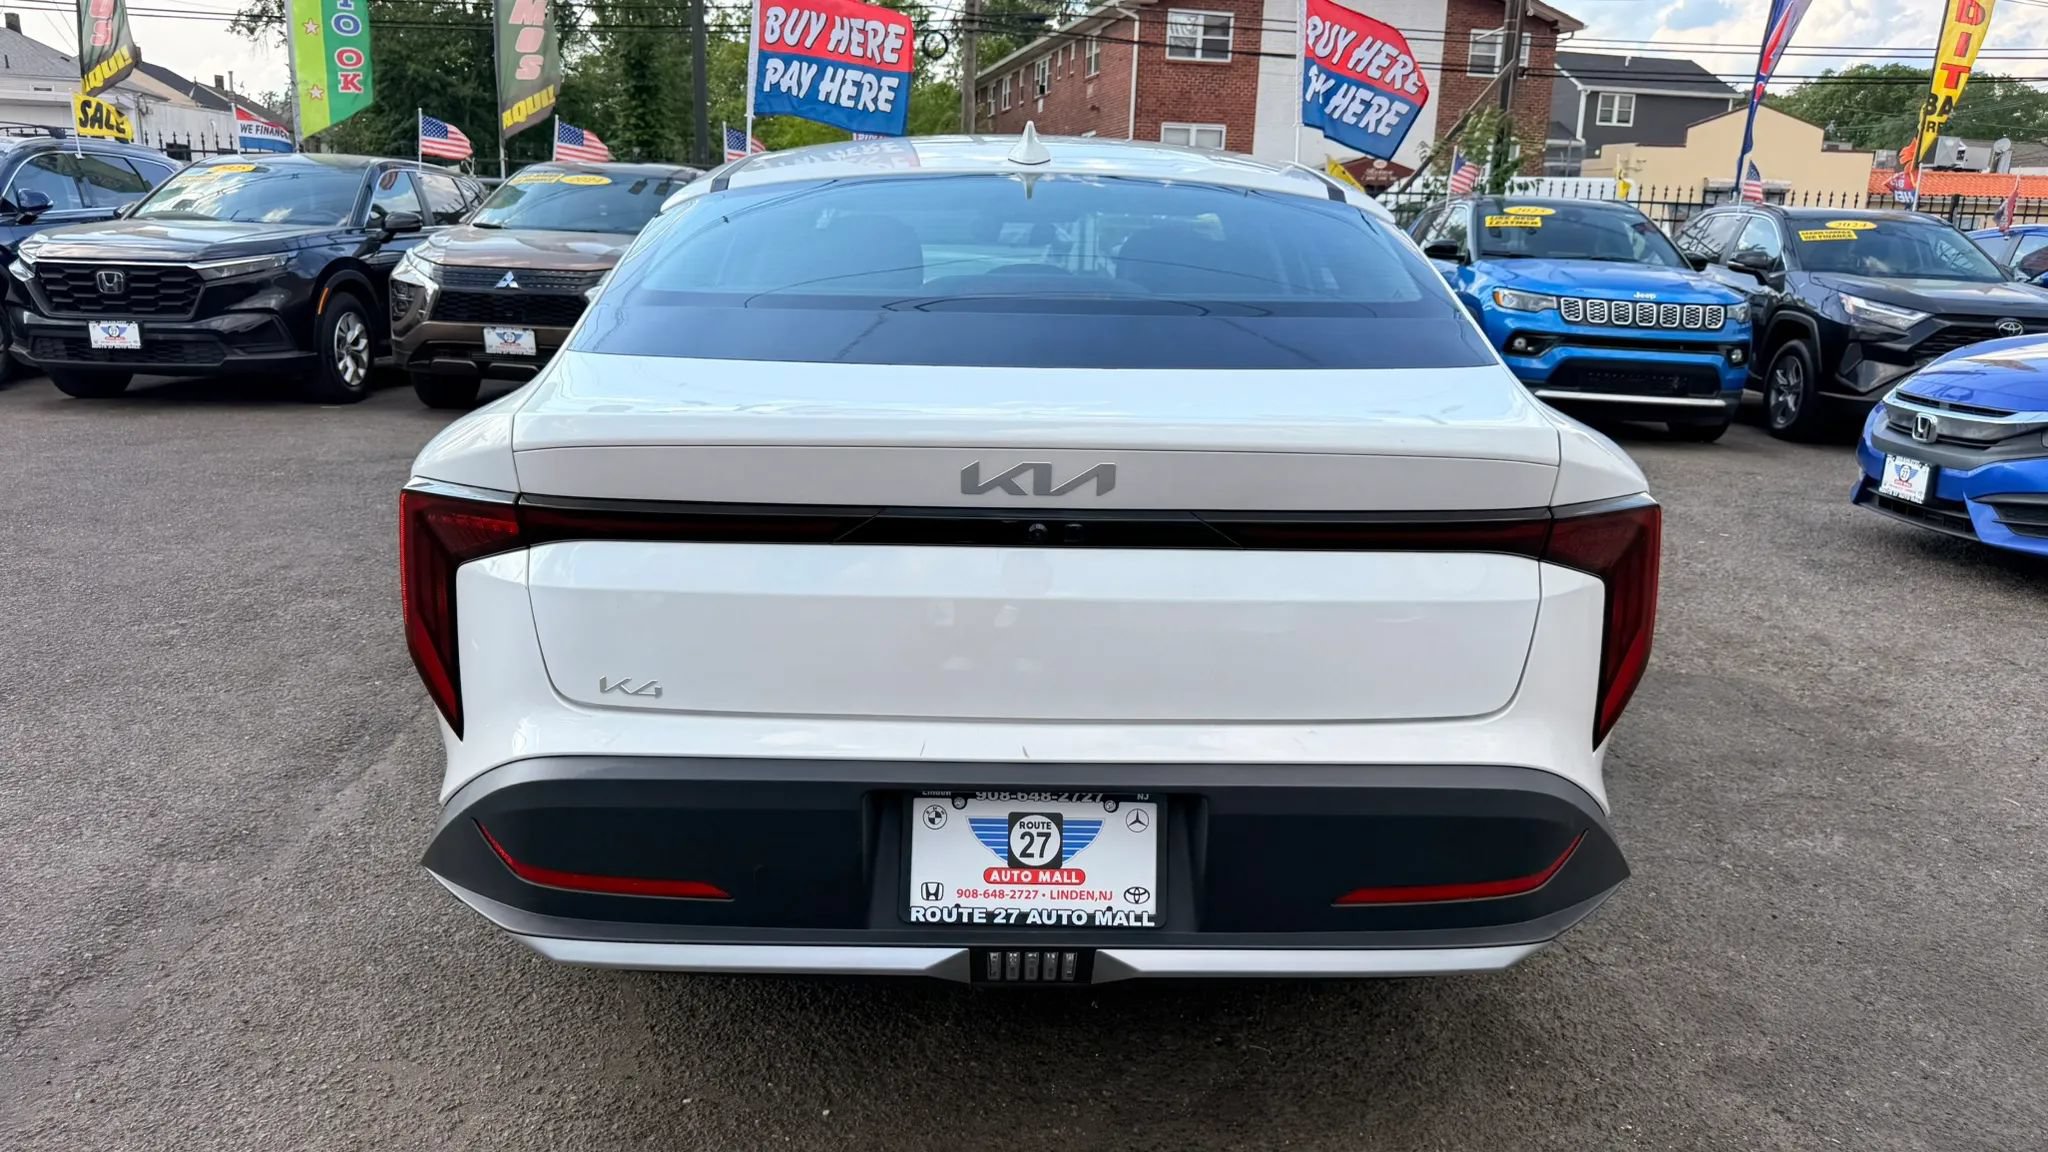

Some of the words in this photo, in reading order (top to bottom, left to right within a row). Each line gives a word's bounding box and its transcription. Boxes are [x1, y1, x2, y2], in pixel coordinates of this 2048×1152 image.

[764, 6, 827, 49] BUY
[827, 16, 906, 64] HERE
[334, 47, 365, 93] OK
[1347, 36, 1424, 95] HERE
[763, 58, 818, 99] PAY
[818, 66, 899, 113] HERE
[502, 84, 556, 130] AQUI!
[1324, 82, 1410, 137] HERE
[240, 123, 253, 134] WE
[1633, 291, 1657, 300] Jeep
[960, 460, 1117, 497] KIA
[599, 675, 663, 699] K4
[1137, 793, 1150, 801] NJ
[1019, 820, 1052, 831] ROUTE
[1019, 832, 1052, 859] 27
[990, 869, 1033, 883] AUTO
[1038, 870, 1080, 884] MALL
[956, 888, 1039, 900] 908-648-2727
[910, 906, 987, 923] ROUTE
[993, 908, 1020, 924] 27
[1026, 908, 1088, 925] AUTO
[1095, 910, 1155, 927] MALL
